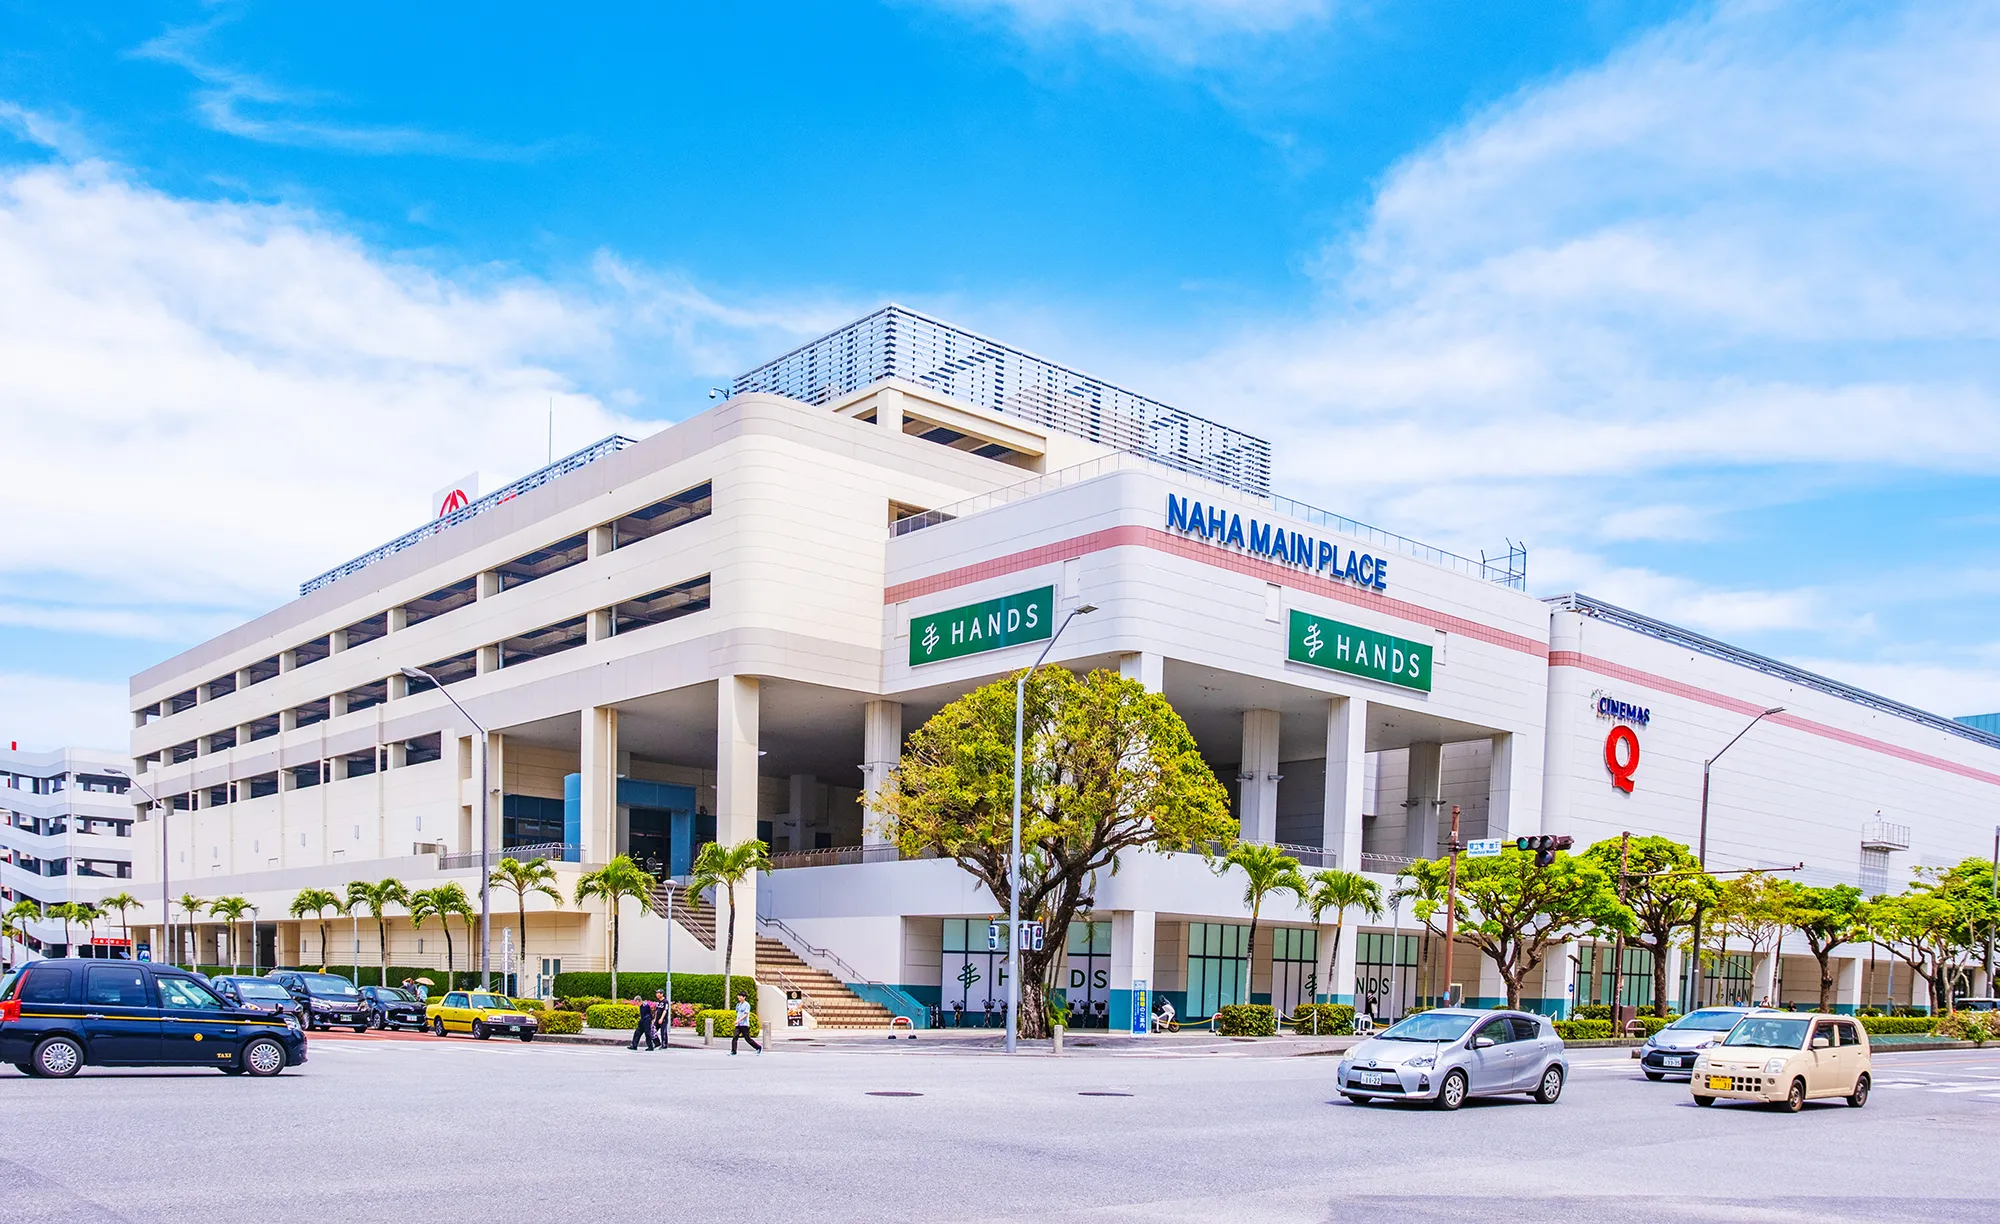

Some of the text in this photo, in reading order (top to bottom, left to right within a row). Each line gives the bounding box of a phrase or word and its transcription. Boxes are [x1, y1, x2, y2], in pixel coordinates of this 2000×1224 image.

[1167, 493, 1388, 590] NAHA MAIN PLACE
[951, 603, 1039, 645] HANDS
[1336, 634, 1420, 678] HANDS
[1599, 696, 1651, 724] CINEMAS
[1605, 725, 1640, 793] Q
[998, 967, 1108, 989] HDS
